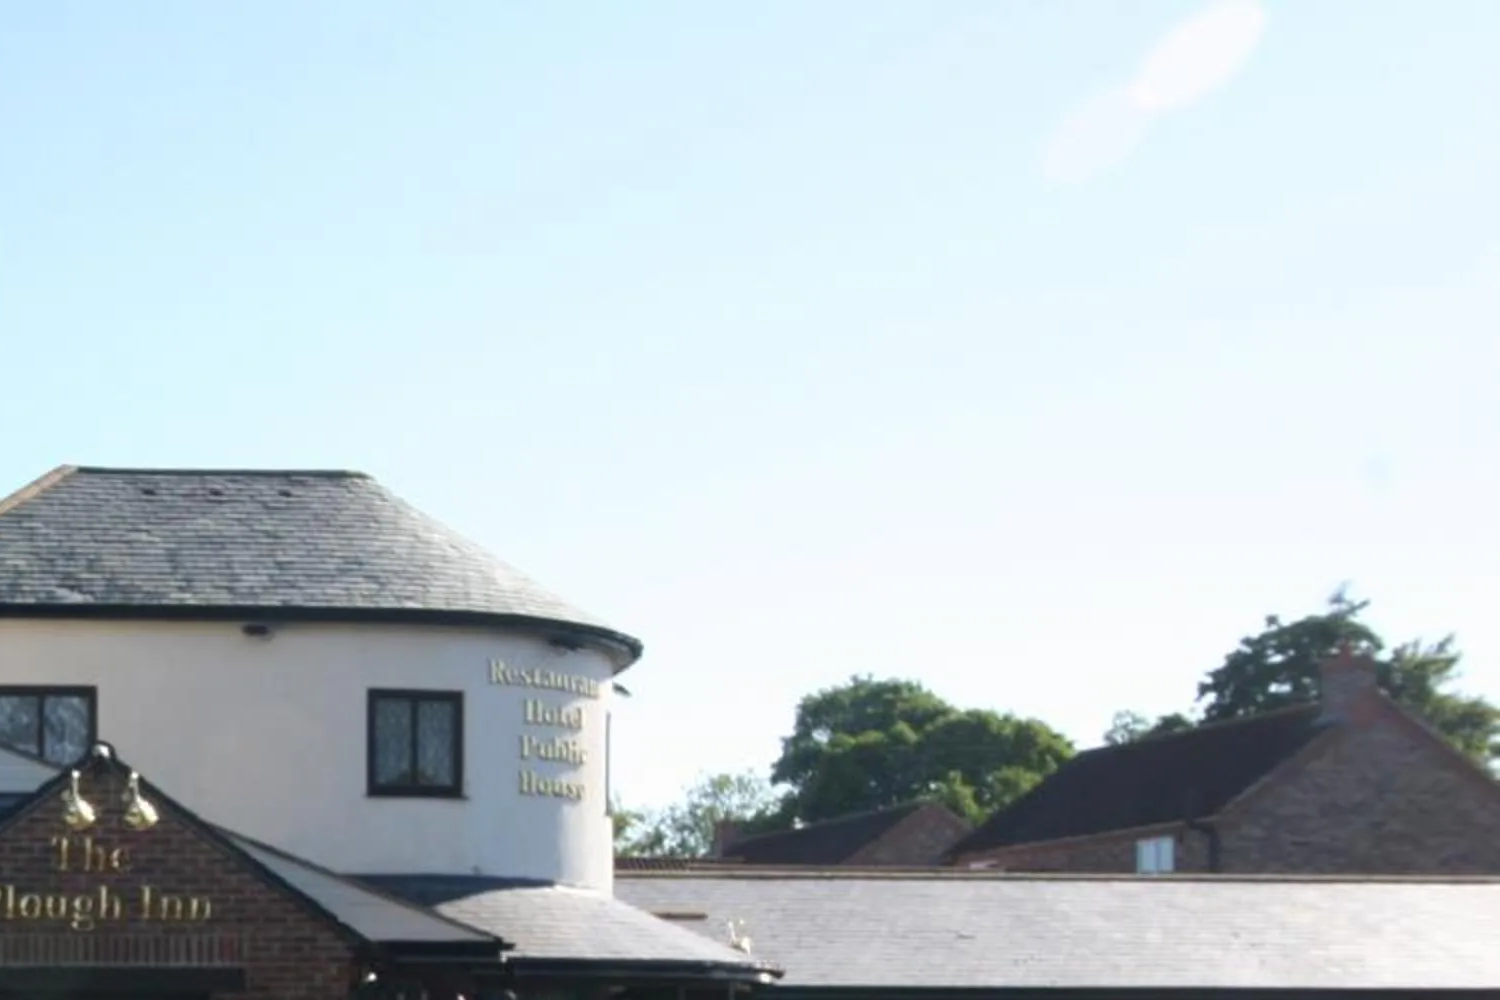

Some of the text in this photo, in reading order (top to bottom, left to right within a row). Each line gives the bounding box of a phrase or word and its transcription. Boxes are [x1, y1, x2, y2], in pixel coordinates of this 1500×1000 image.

[522, 699, 584, 731] Hotel
[519, 734, 589, 768] Public
[51, 835, 132, 873] The
[139, 884, 214, 921] Inn
